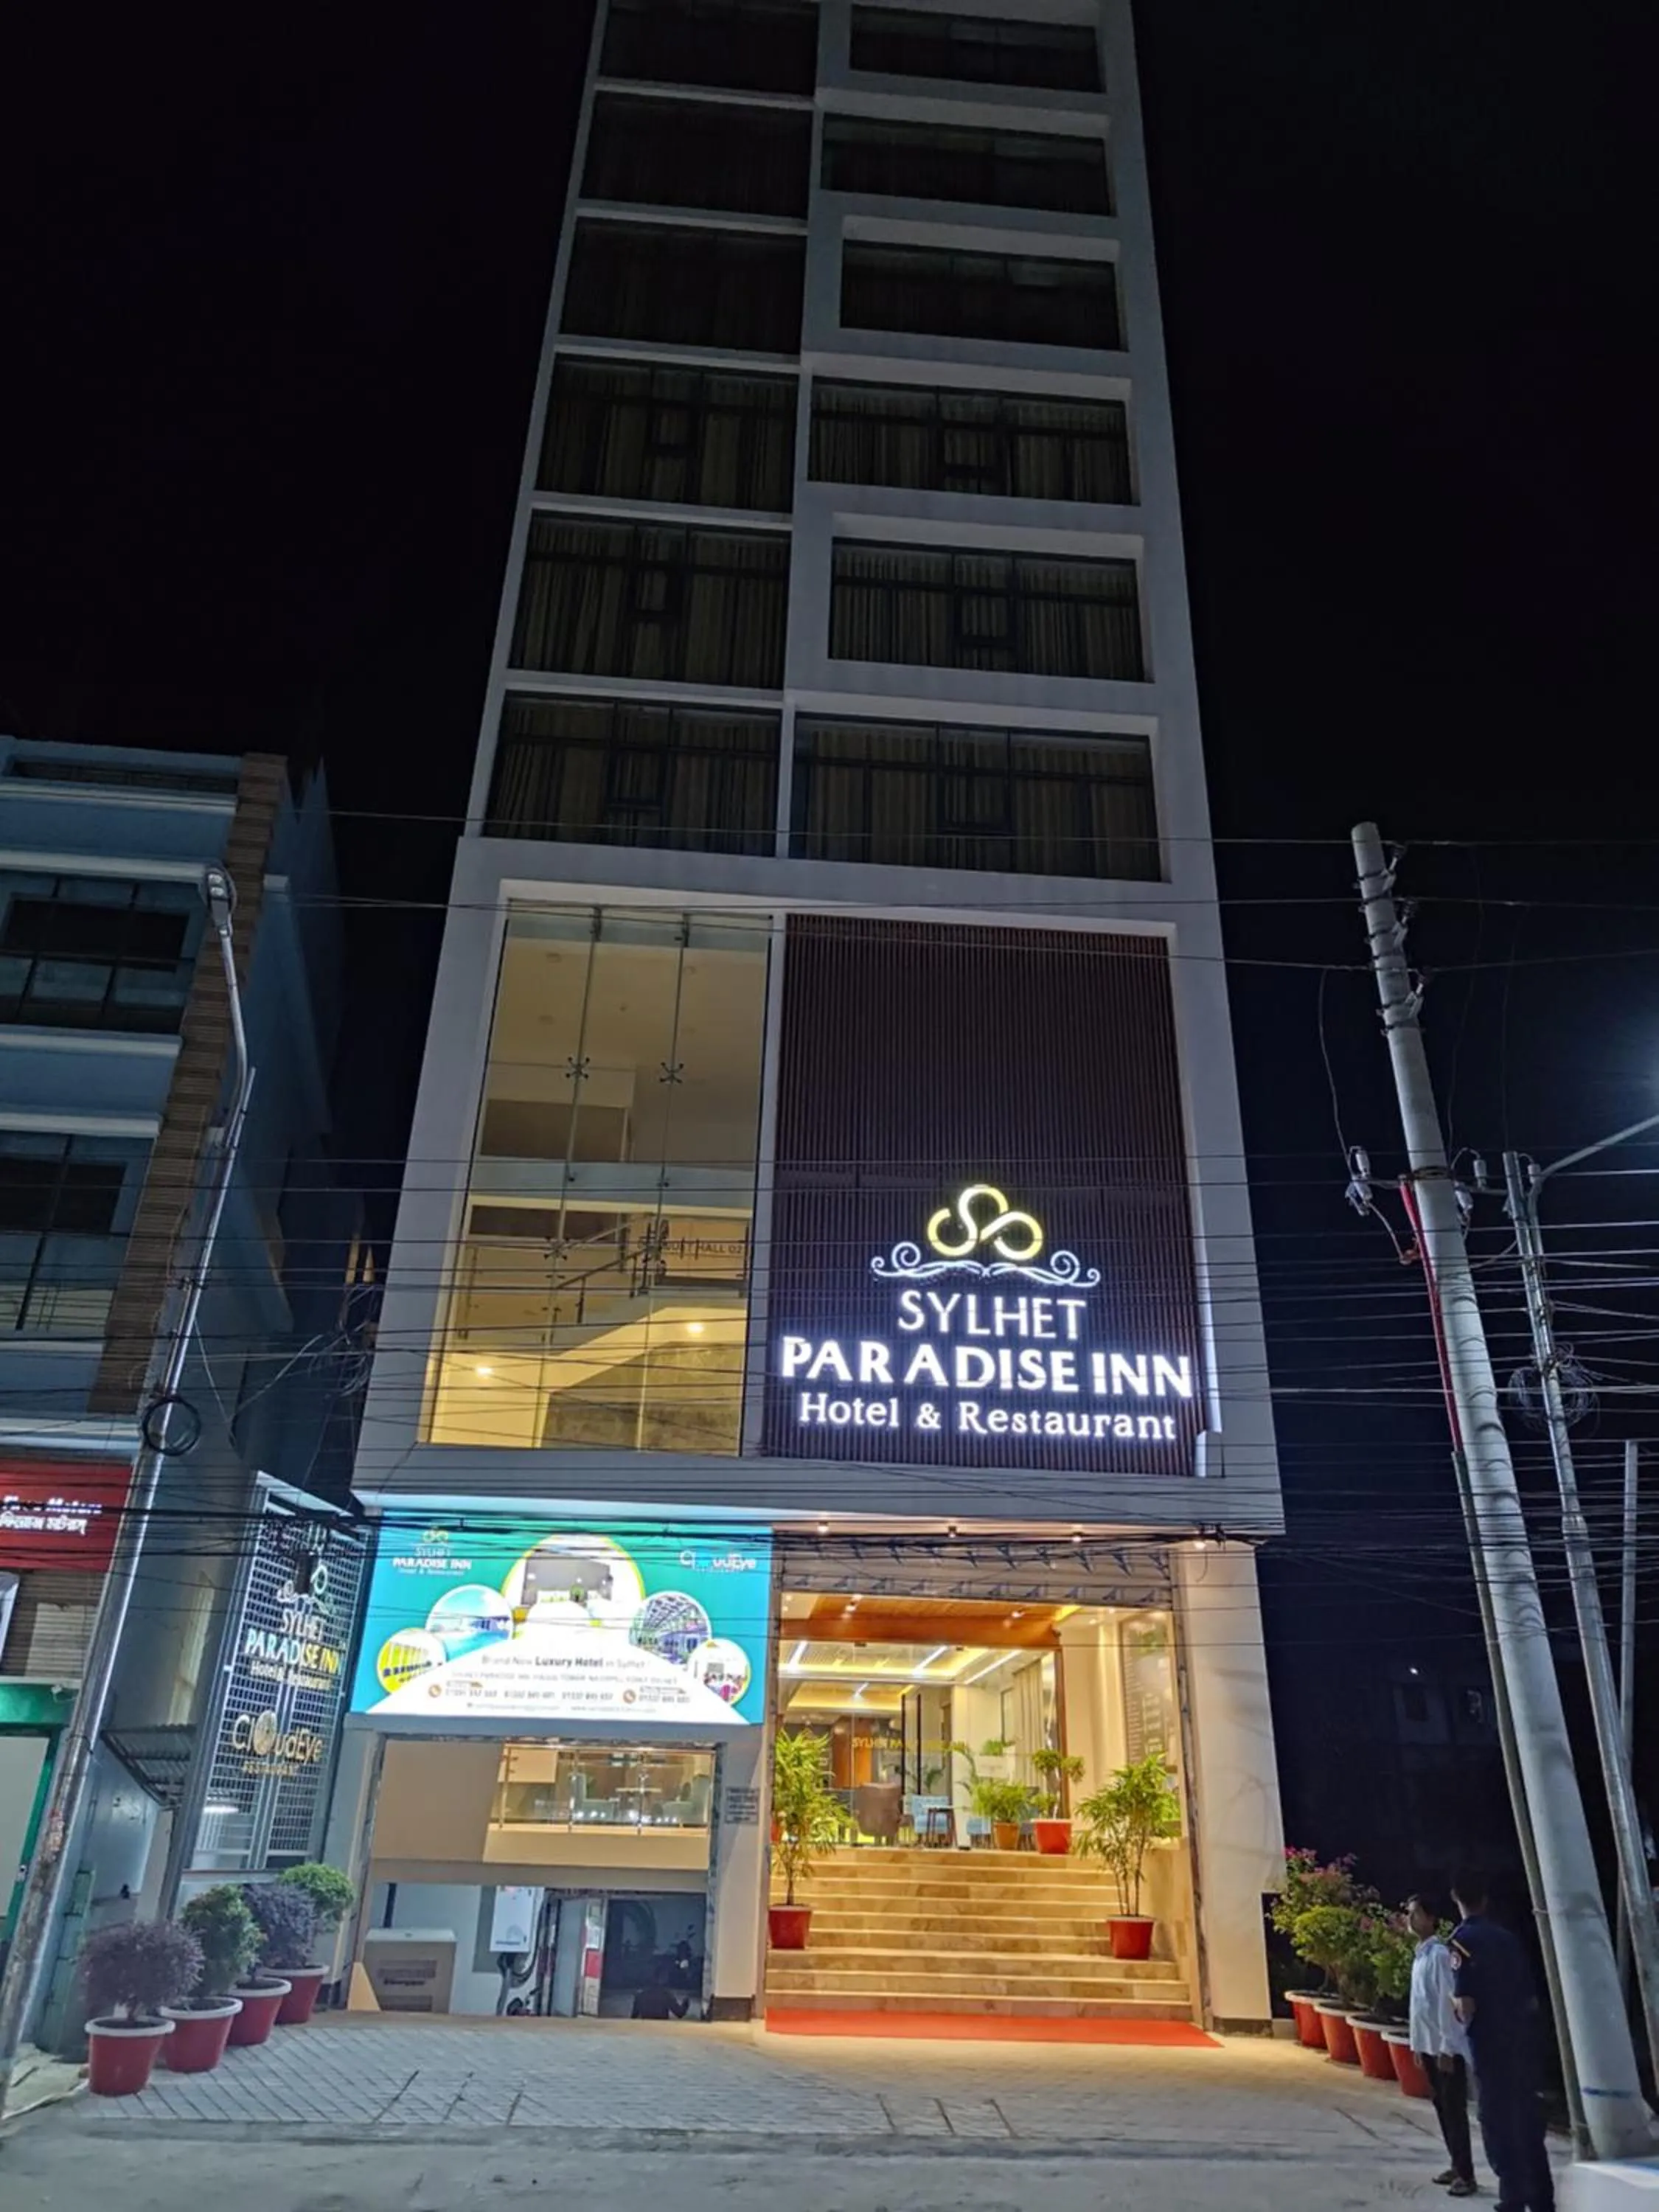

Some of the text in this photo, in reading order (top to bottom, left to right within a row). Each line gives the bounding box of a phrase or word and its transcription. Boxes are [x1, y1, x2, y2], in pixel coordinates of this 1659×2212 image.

[897, 1289, 1087, 1340] SYLHET
[782, 1336, 1193, 1398] PARADISE INN
[799, 1392, 1178, 1440] Hotel & Restaurant
[280, 1608, 326, 1641] SYLHET
[245, 1628, 320, 1669] PARADISE
[535, 1656, 573, 1668] Luxury
[575, 1657, 603, 1667] Hotel
